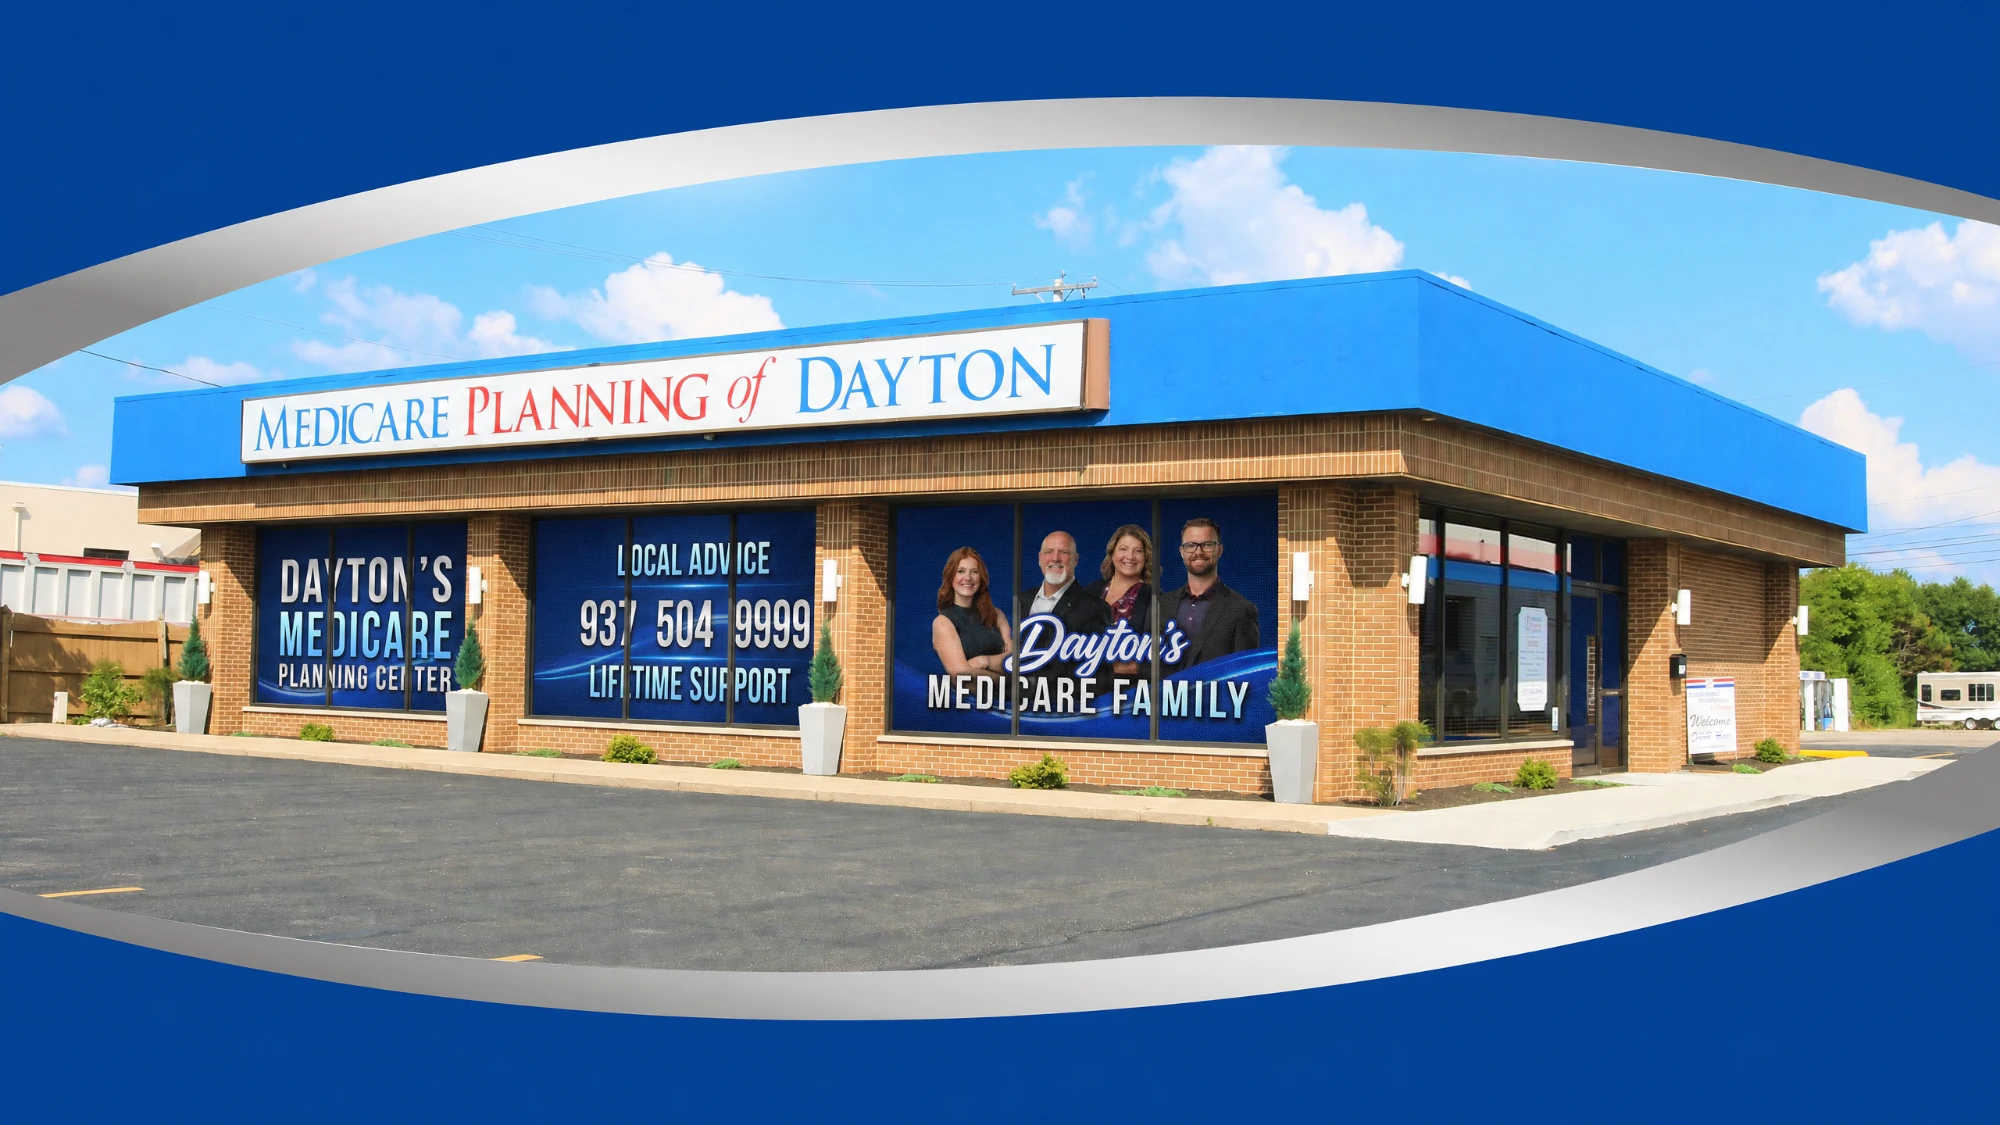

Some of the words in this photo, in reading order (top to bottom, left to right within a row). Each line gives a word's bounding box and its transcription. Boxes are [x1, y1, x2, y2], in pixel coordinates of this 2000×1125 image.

[254, 396, 450, 451] MEDICARE
[464, 373, 709, 437] PLANNING
[727, 356, 776, 423] of
[795, 343, 1056, 414] DAYTON
[281, 555, 453, 603] DAYTON'S
[617, 543, 682, 577] LOCAL
[688, 541, 770, 575] ADVICE
[279, 610, 452, 660] MEDICARE
[580, 599, 637, 646] 937
[656, 599, 713, 648] 504
[735, 599, 811, 649] 9999
[1004, 613, 1190, 677] Dayton's
[278, 663, 368, 690] PLANNING
[690, 666, 791, 704] SUPPORT
[928, 674, 1097, 714] MEDICARE
[1113, 679, 1249, 719] FAMILY
[1690, 715, 1732, 728] Welcome
